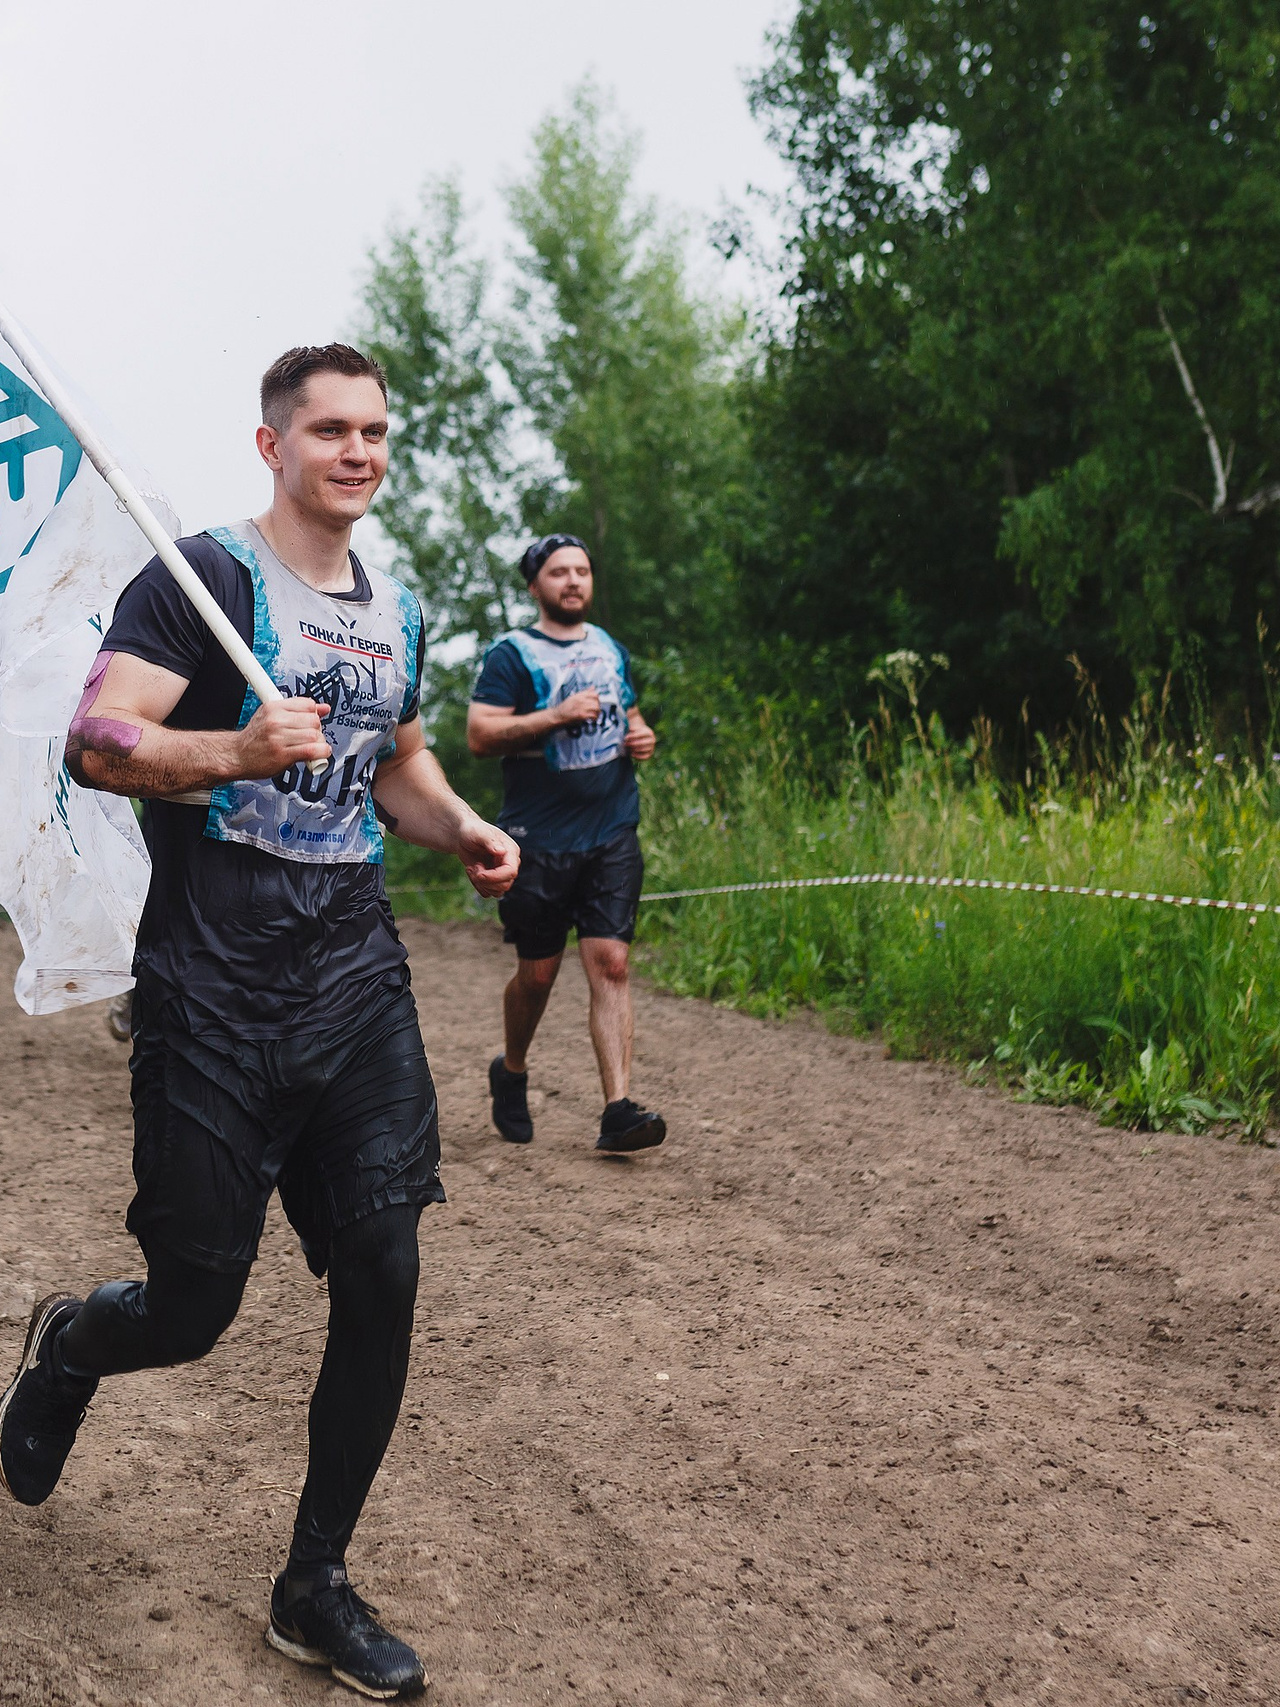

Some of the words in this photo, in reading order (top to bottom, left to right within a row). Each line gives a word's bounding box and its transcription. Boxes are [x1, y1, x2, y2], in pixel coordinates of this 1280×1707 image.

[299, 620, 346, 646] ГОНКА
[349, 635, 393, 657] ГЕРОЕВ
[336, 714, 389, 734] Взыскания
